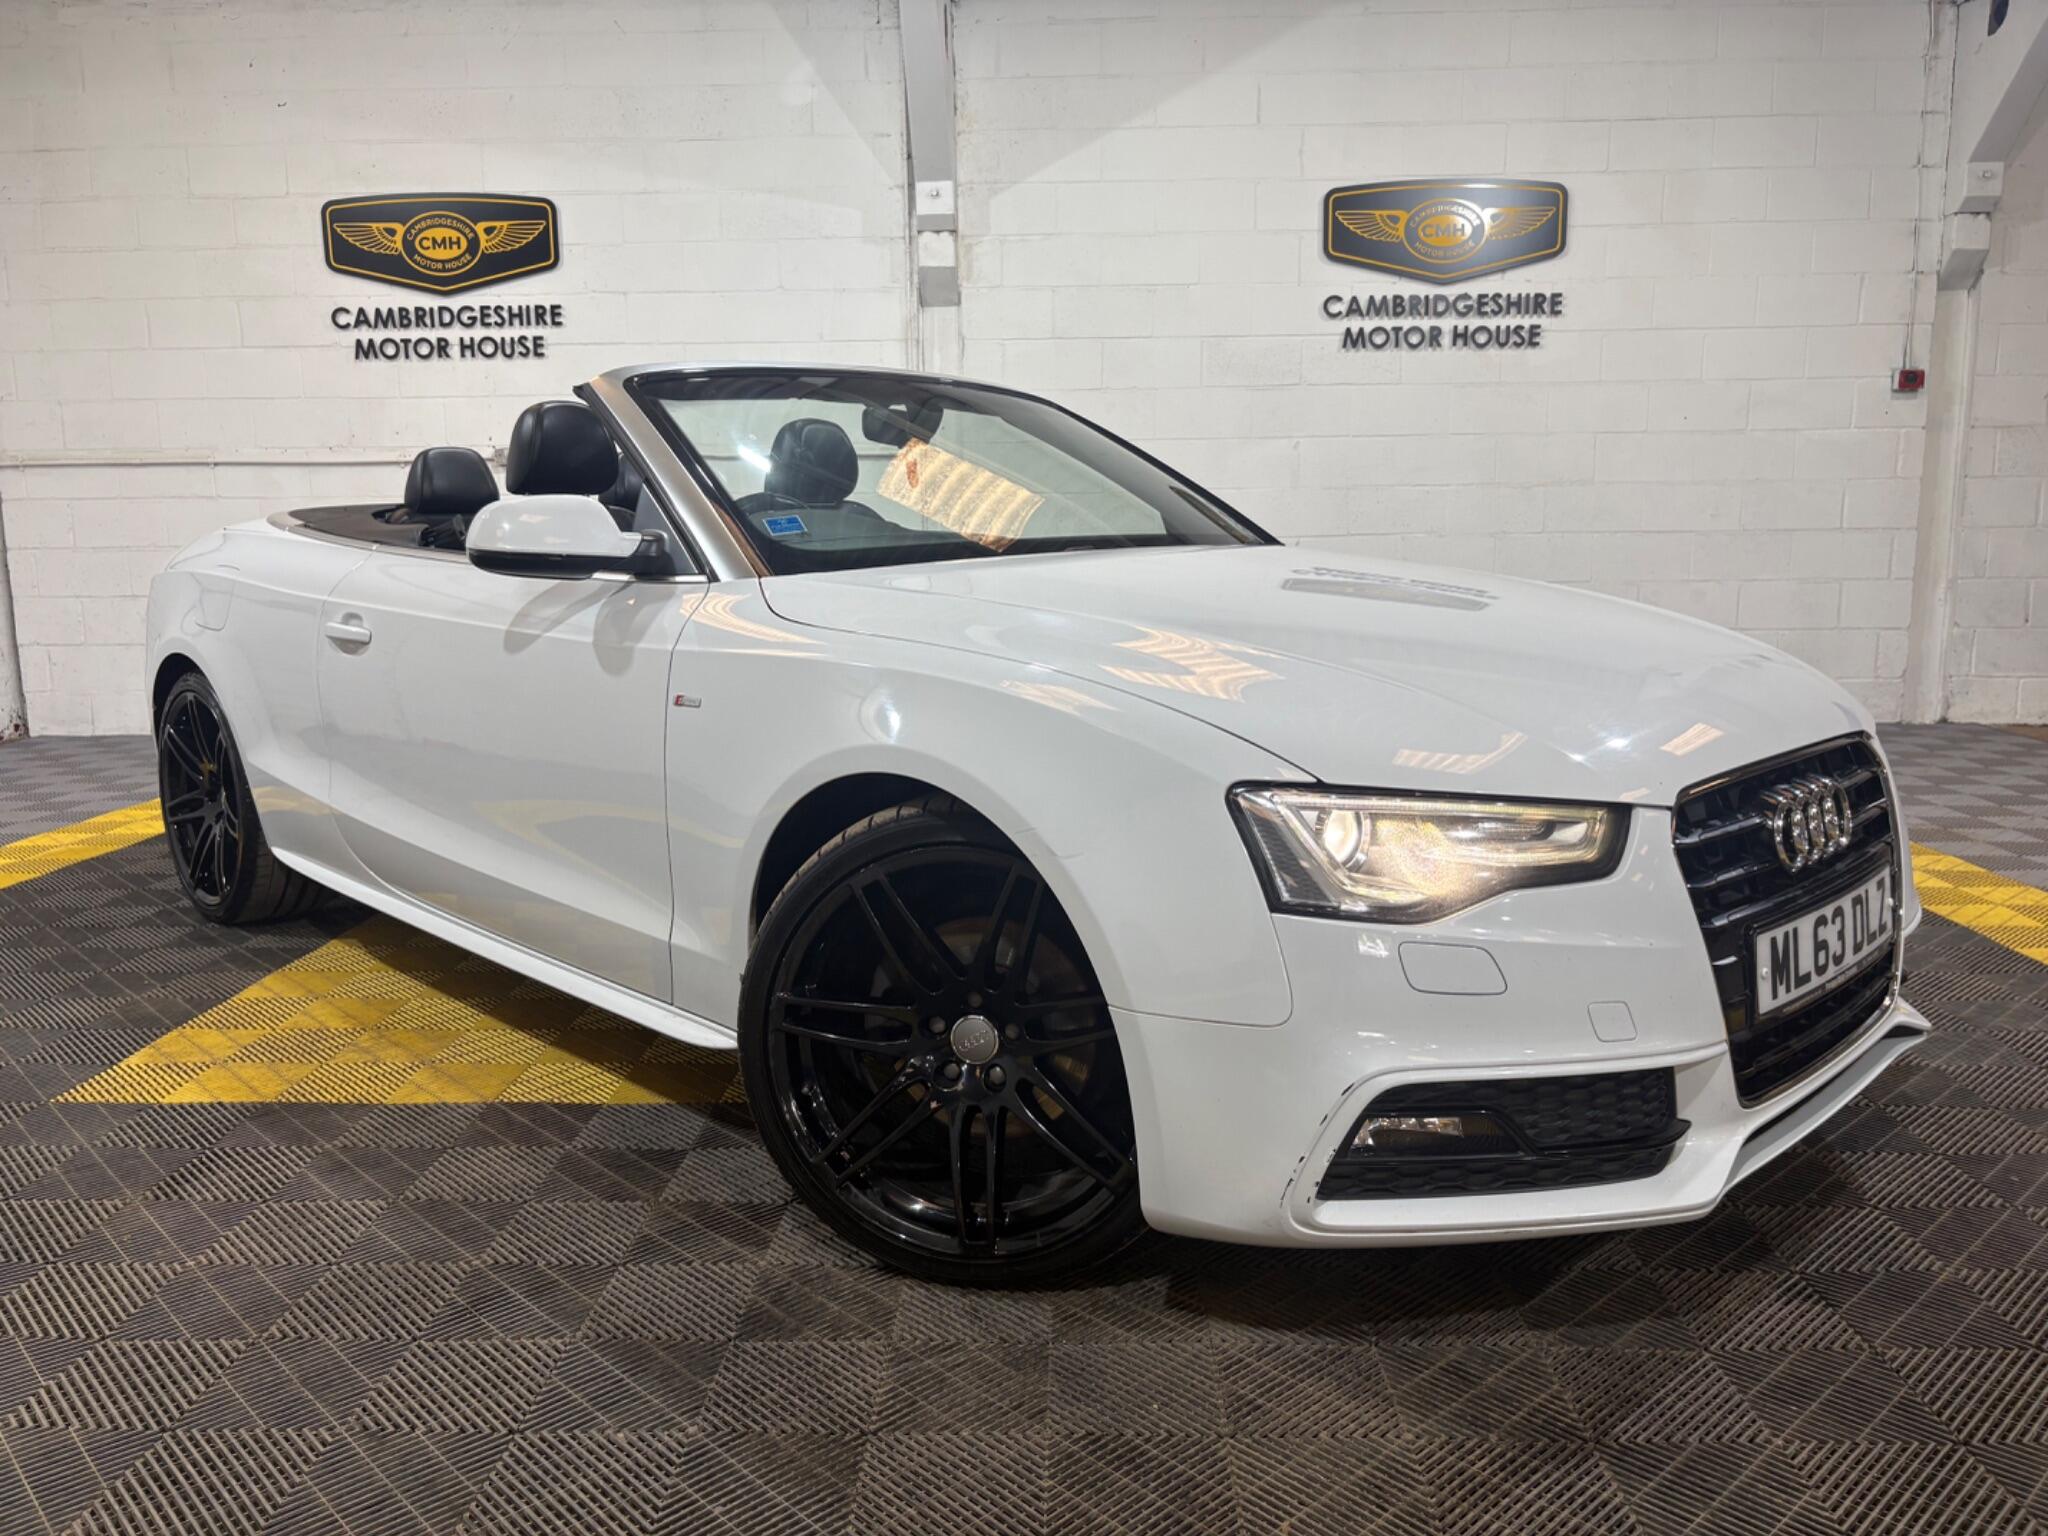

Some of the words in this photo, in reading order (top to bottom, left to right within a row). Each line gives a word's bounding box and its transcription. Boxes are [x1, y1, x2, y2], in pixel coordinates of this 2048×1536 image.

[407, 217, 475, 240] CAMBRIDGESHIRE
[1422, 223, 1465, 237] CMH
[419, 236, 461, 250] CMH
[413, 253, 443, 269] MOTOR
[445, 253, 472, 270] HOUSE
[331, 304, 563, 329] CAMBRIDGESHIRE
[1323, 293, 1563, 318] CAMBRIDGESHIRE
[355, 337, 450, 360] MOTOR
[459, 335, 545, 359] HOUSE
[1342, 326, 1442, 349] MOTOR
[1452, 324, 1541, 348] HOUSE
[1770, 905, 1846, 1000] ML63
[1851, 877, 1887, 957] DLZ
